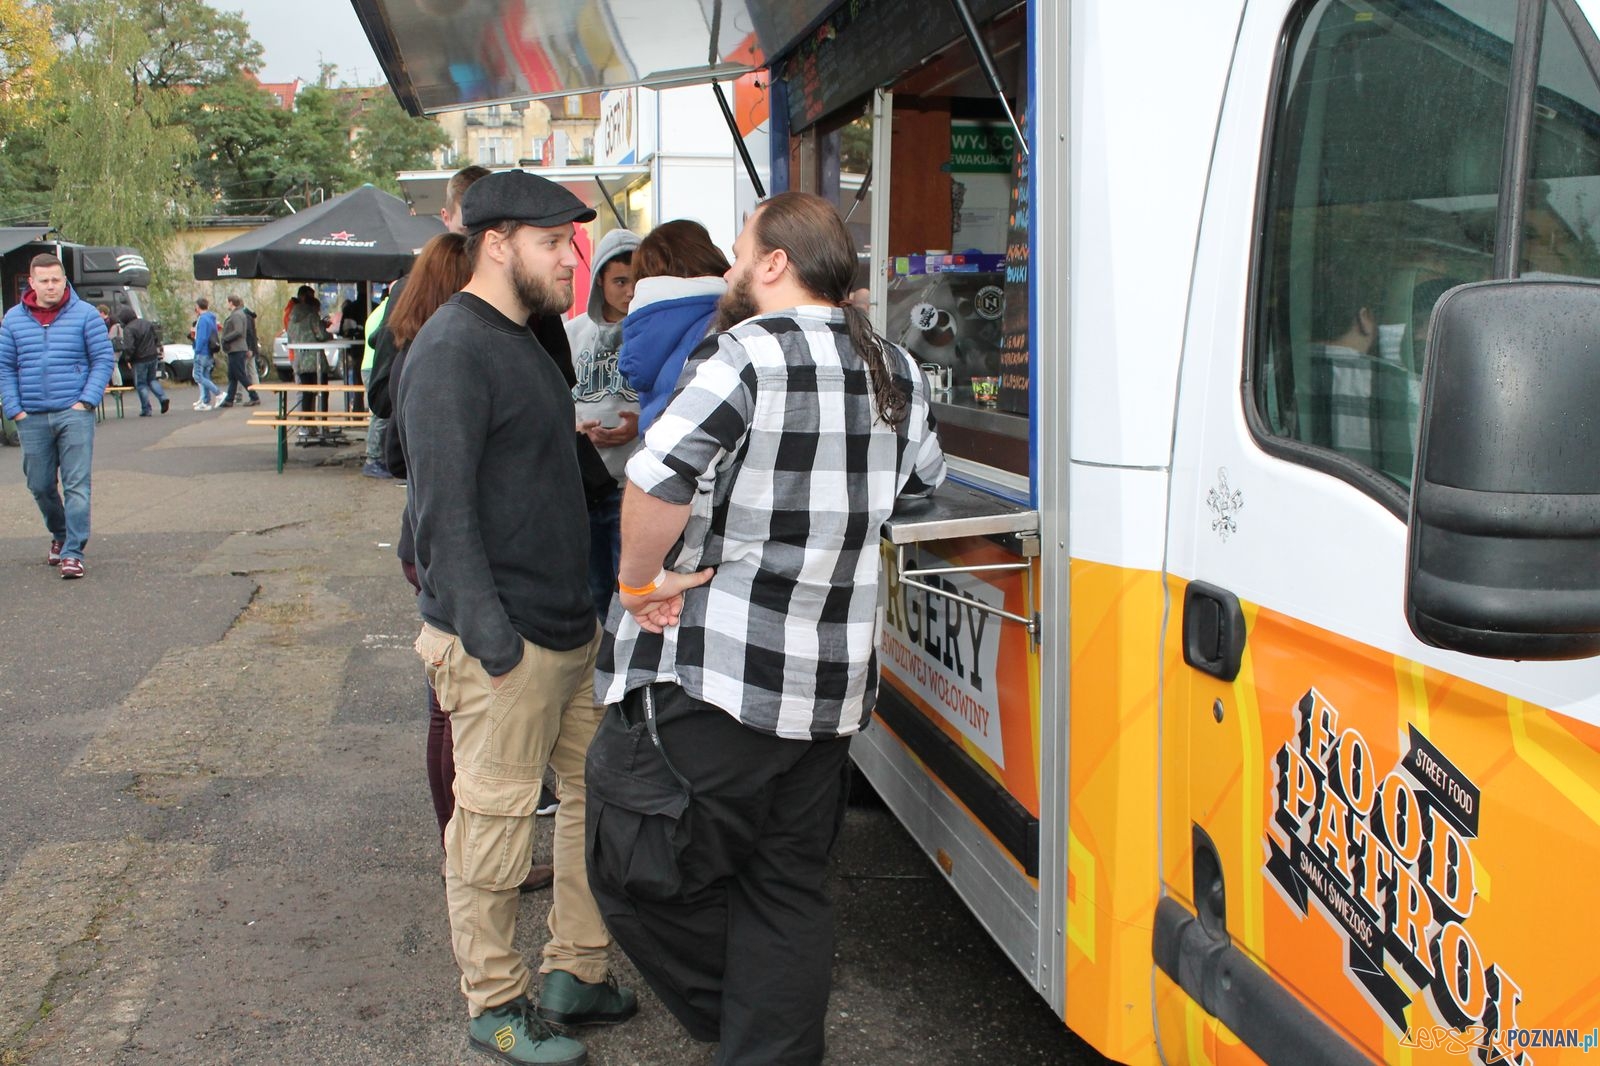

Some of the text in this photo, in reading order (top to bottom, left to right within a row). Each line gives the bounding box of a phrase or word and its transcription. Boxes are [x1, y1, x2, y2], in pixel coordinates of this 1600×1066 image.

[299, 238, 376, 248] Heineken
[928, 667, 989, 737] WOŁOWINY
[1302, 686, 1478, 919] FOOD
[1415, 748, 1473, 815] STREET FOOD
[1278, 741, 1534, 1066] PATROL
[1300, 851, 1323, 889] SMAK
